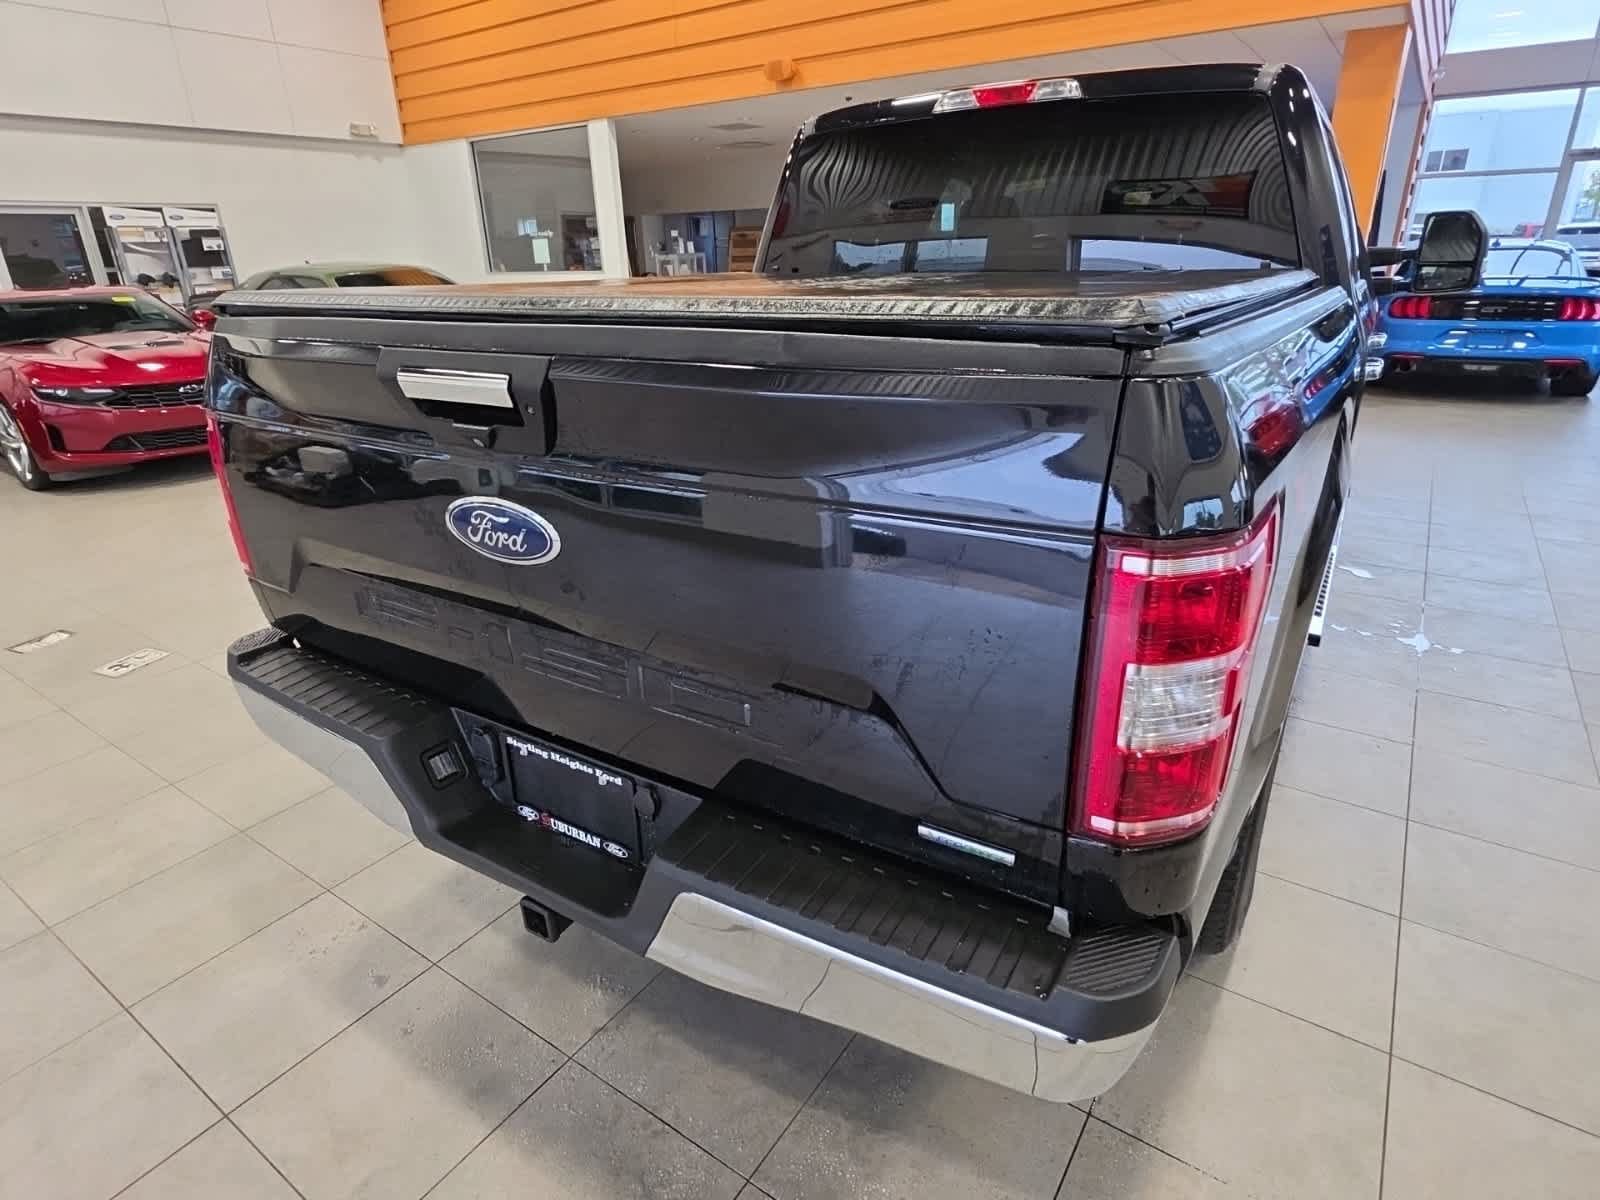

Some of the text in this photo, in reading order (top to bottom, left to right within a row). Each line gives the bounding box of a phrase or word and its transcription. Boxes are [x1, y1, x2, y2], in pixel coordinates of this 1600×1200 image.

[467, 509, 528, 553] Ford
[506, 736, 623, 786] Sterling Heights Ford
[541, 812, 601, 849] SUBURBAN
